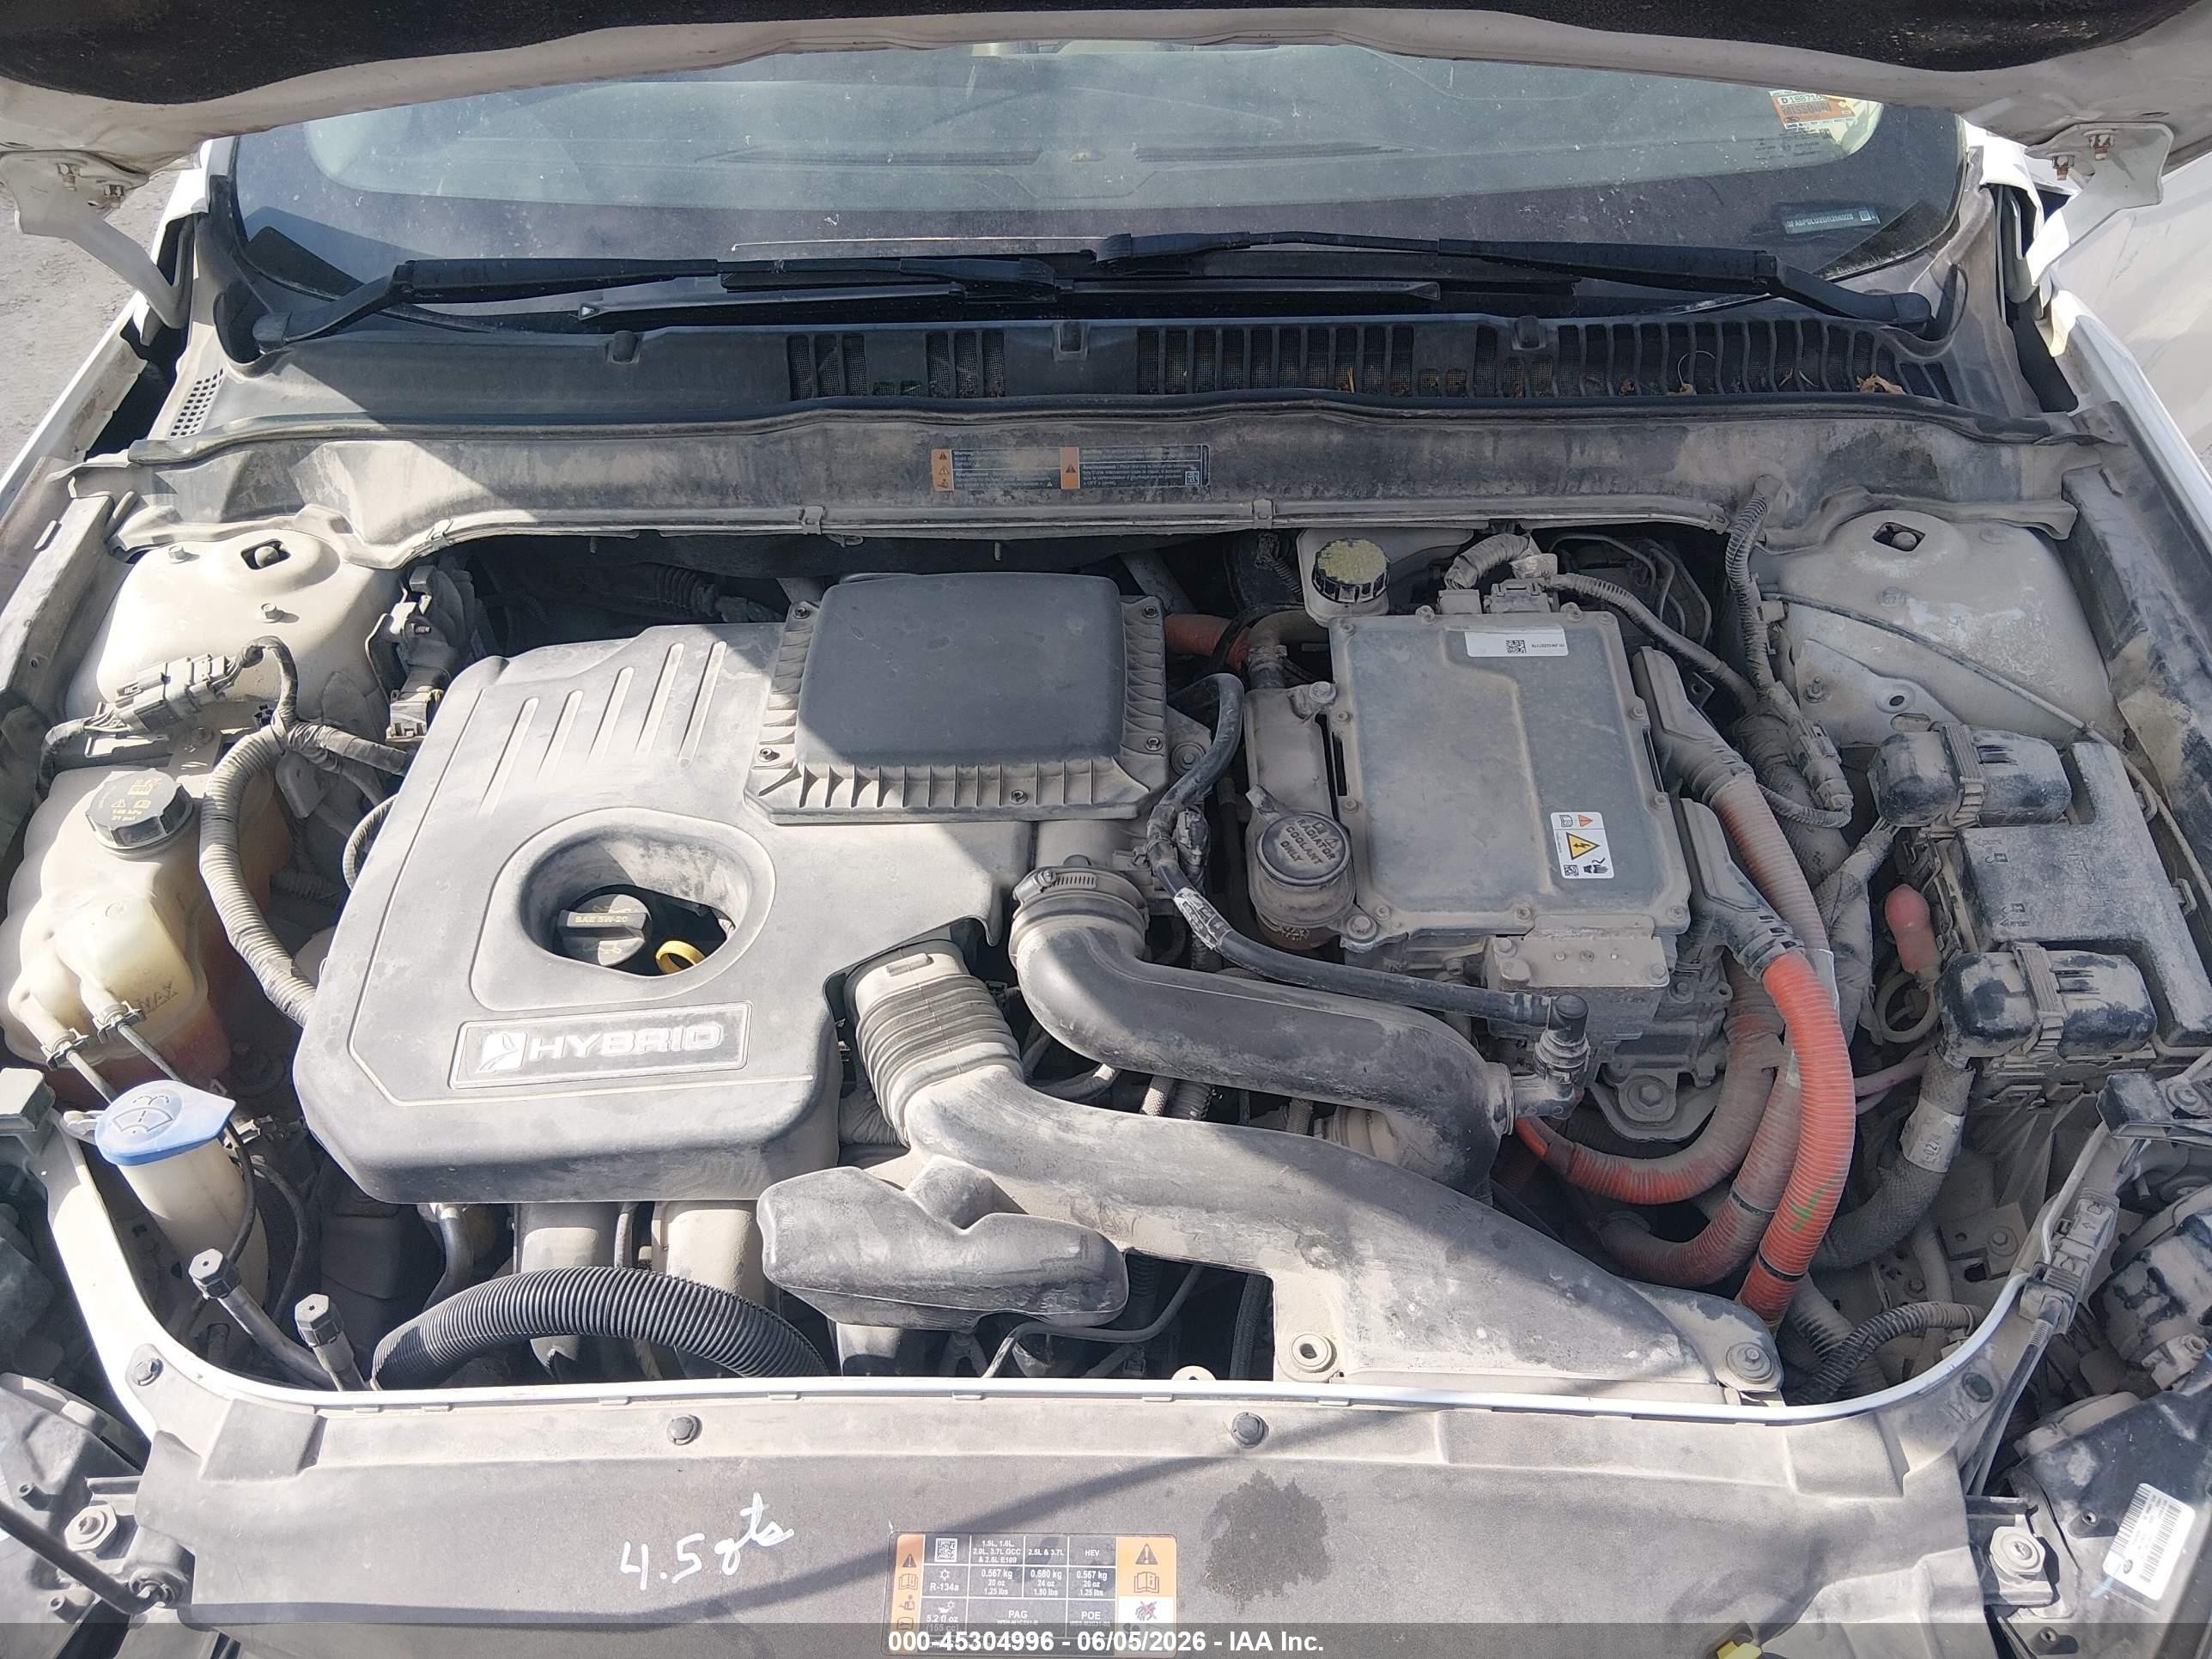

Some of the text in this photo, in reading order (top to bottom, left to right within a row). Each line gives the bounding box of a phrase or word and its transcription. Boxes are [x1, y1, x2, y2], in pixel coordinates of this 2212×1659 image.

[1297, 819, 1335, 860] RADIATOR
[1286, 826, 1323, 865] COOLANT
[1280, 841, 1304, 862] ONLY
[528, 1022, 723, 1062] HYBRID
[620, 1533, 706, 1590] 4.5
[1003, 1569, 1013, 1579] kg
[1030, 1570, 1061, 1580] 0.680 kg
[1097, 1571, 1108, 1581] kg
[930, 1583, 959, 1592] R-134a
[926, 1614, 938, 1623] 5.2
[1082, 1611, 1101, 1620] POE
